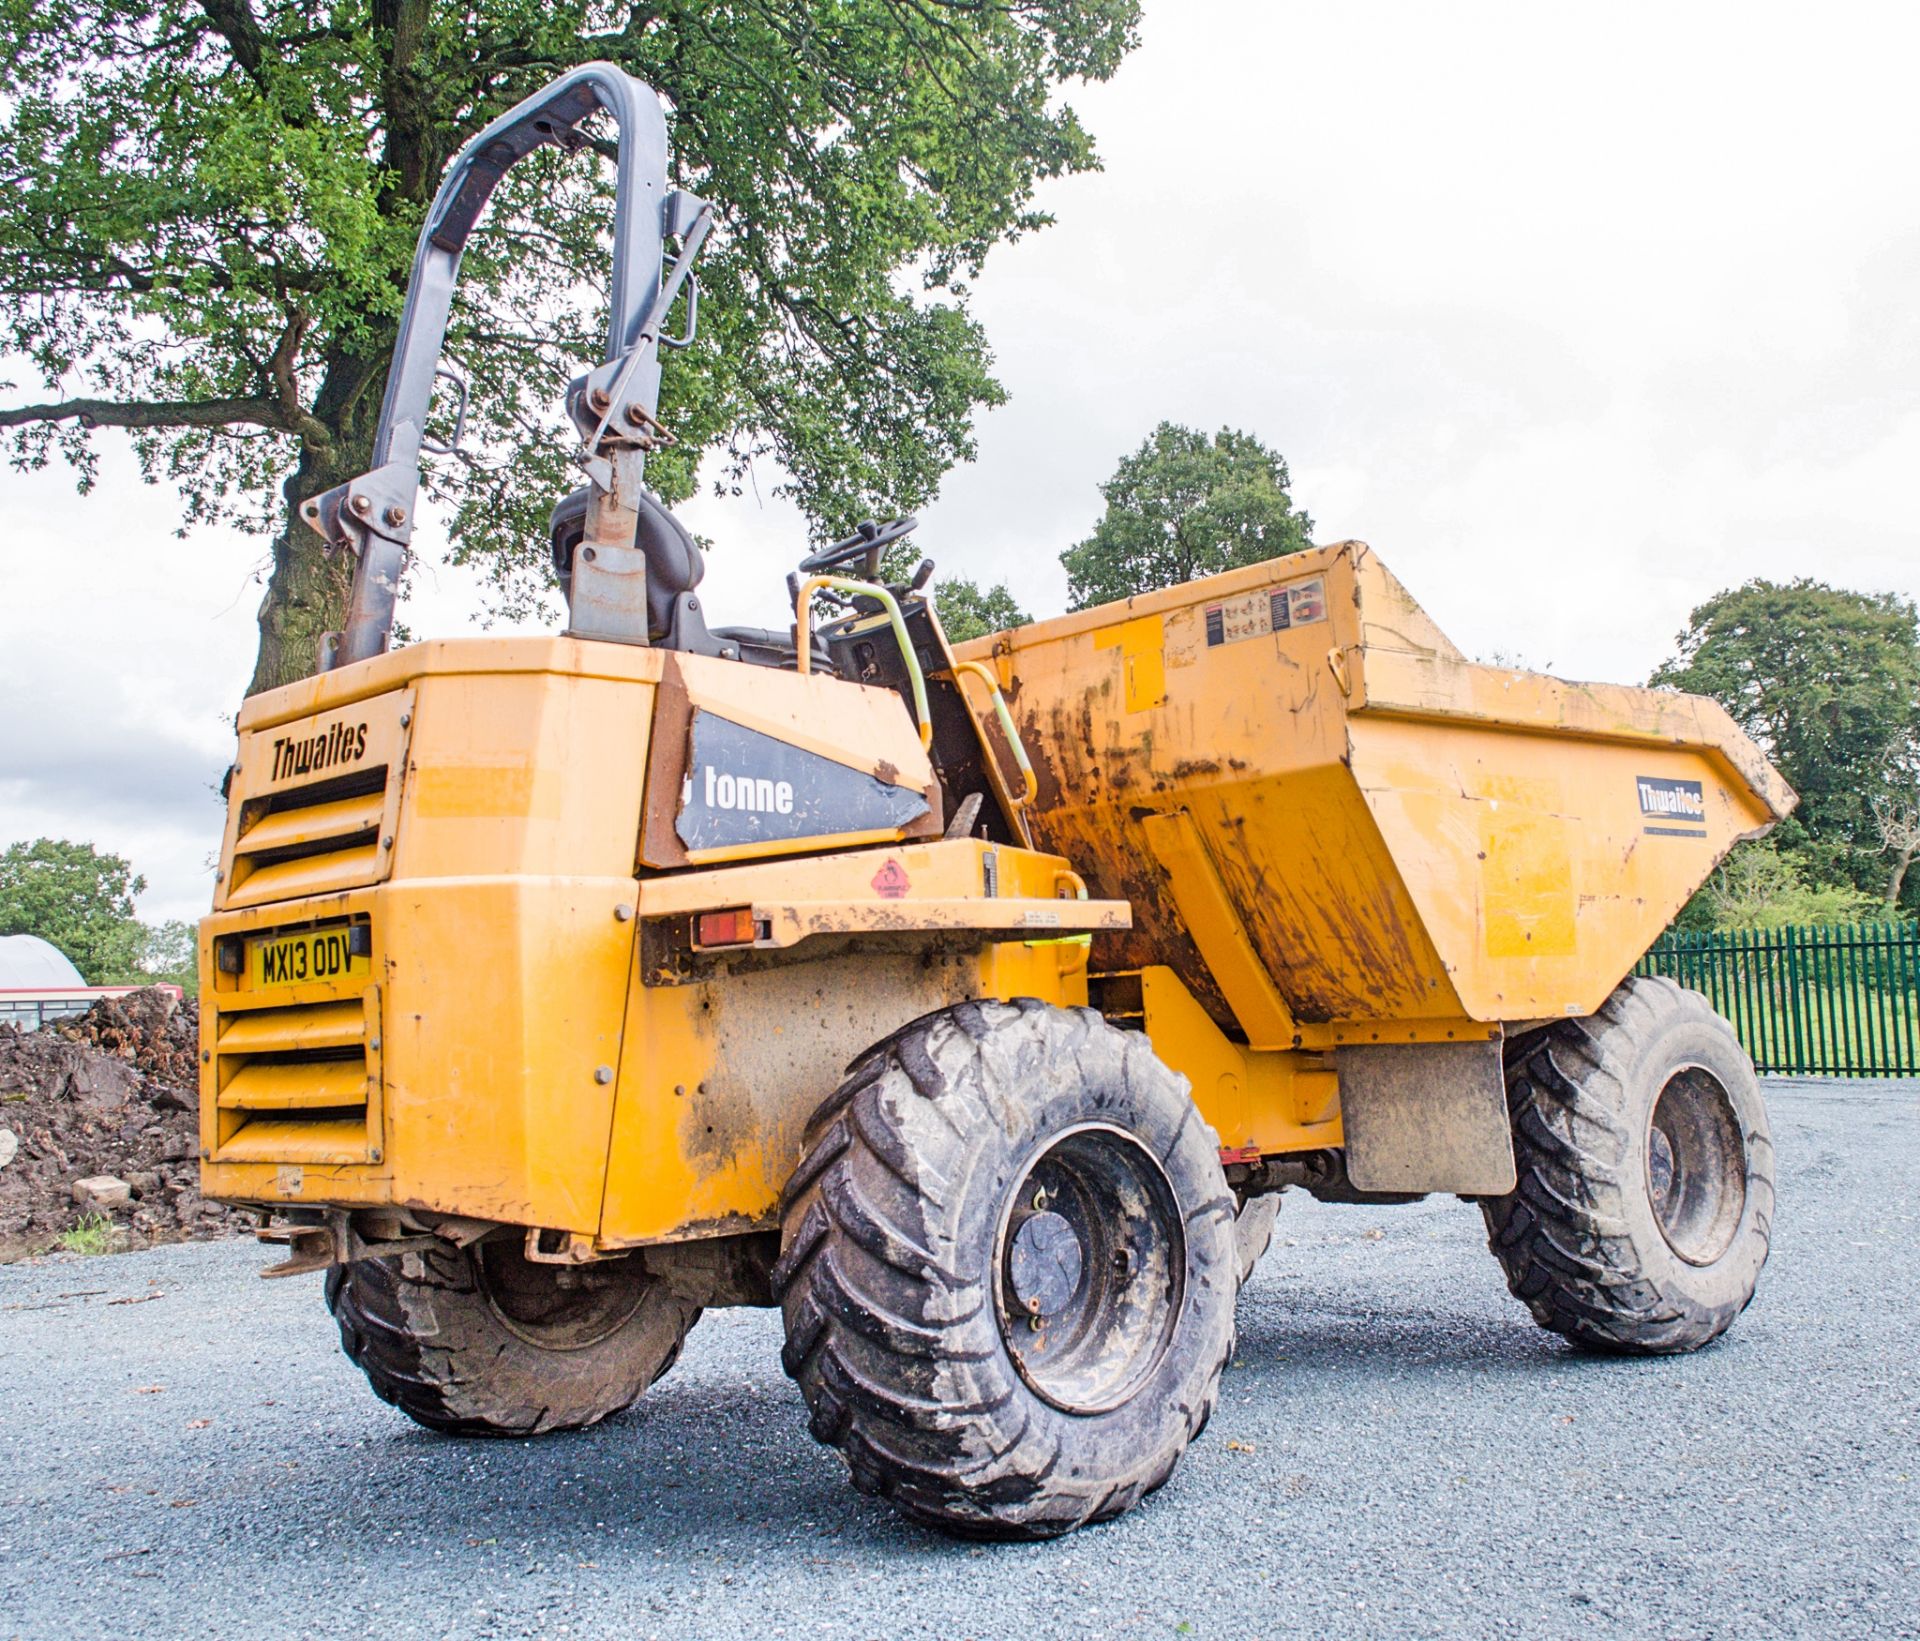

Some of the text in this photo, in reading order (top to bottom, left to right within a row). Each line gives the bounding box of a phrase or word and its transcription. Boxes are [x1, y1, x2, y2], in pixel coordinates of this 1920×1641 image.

[271, 721, 367, 781] Thwaites
[705, 765, 793, 814] tonne
[263, 941, 307, 984] MX13
